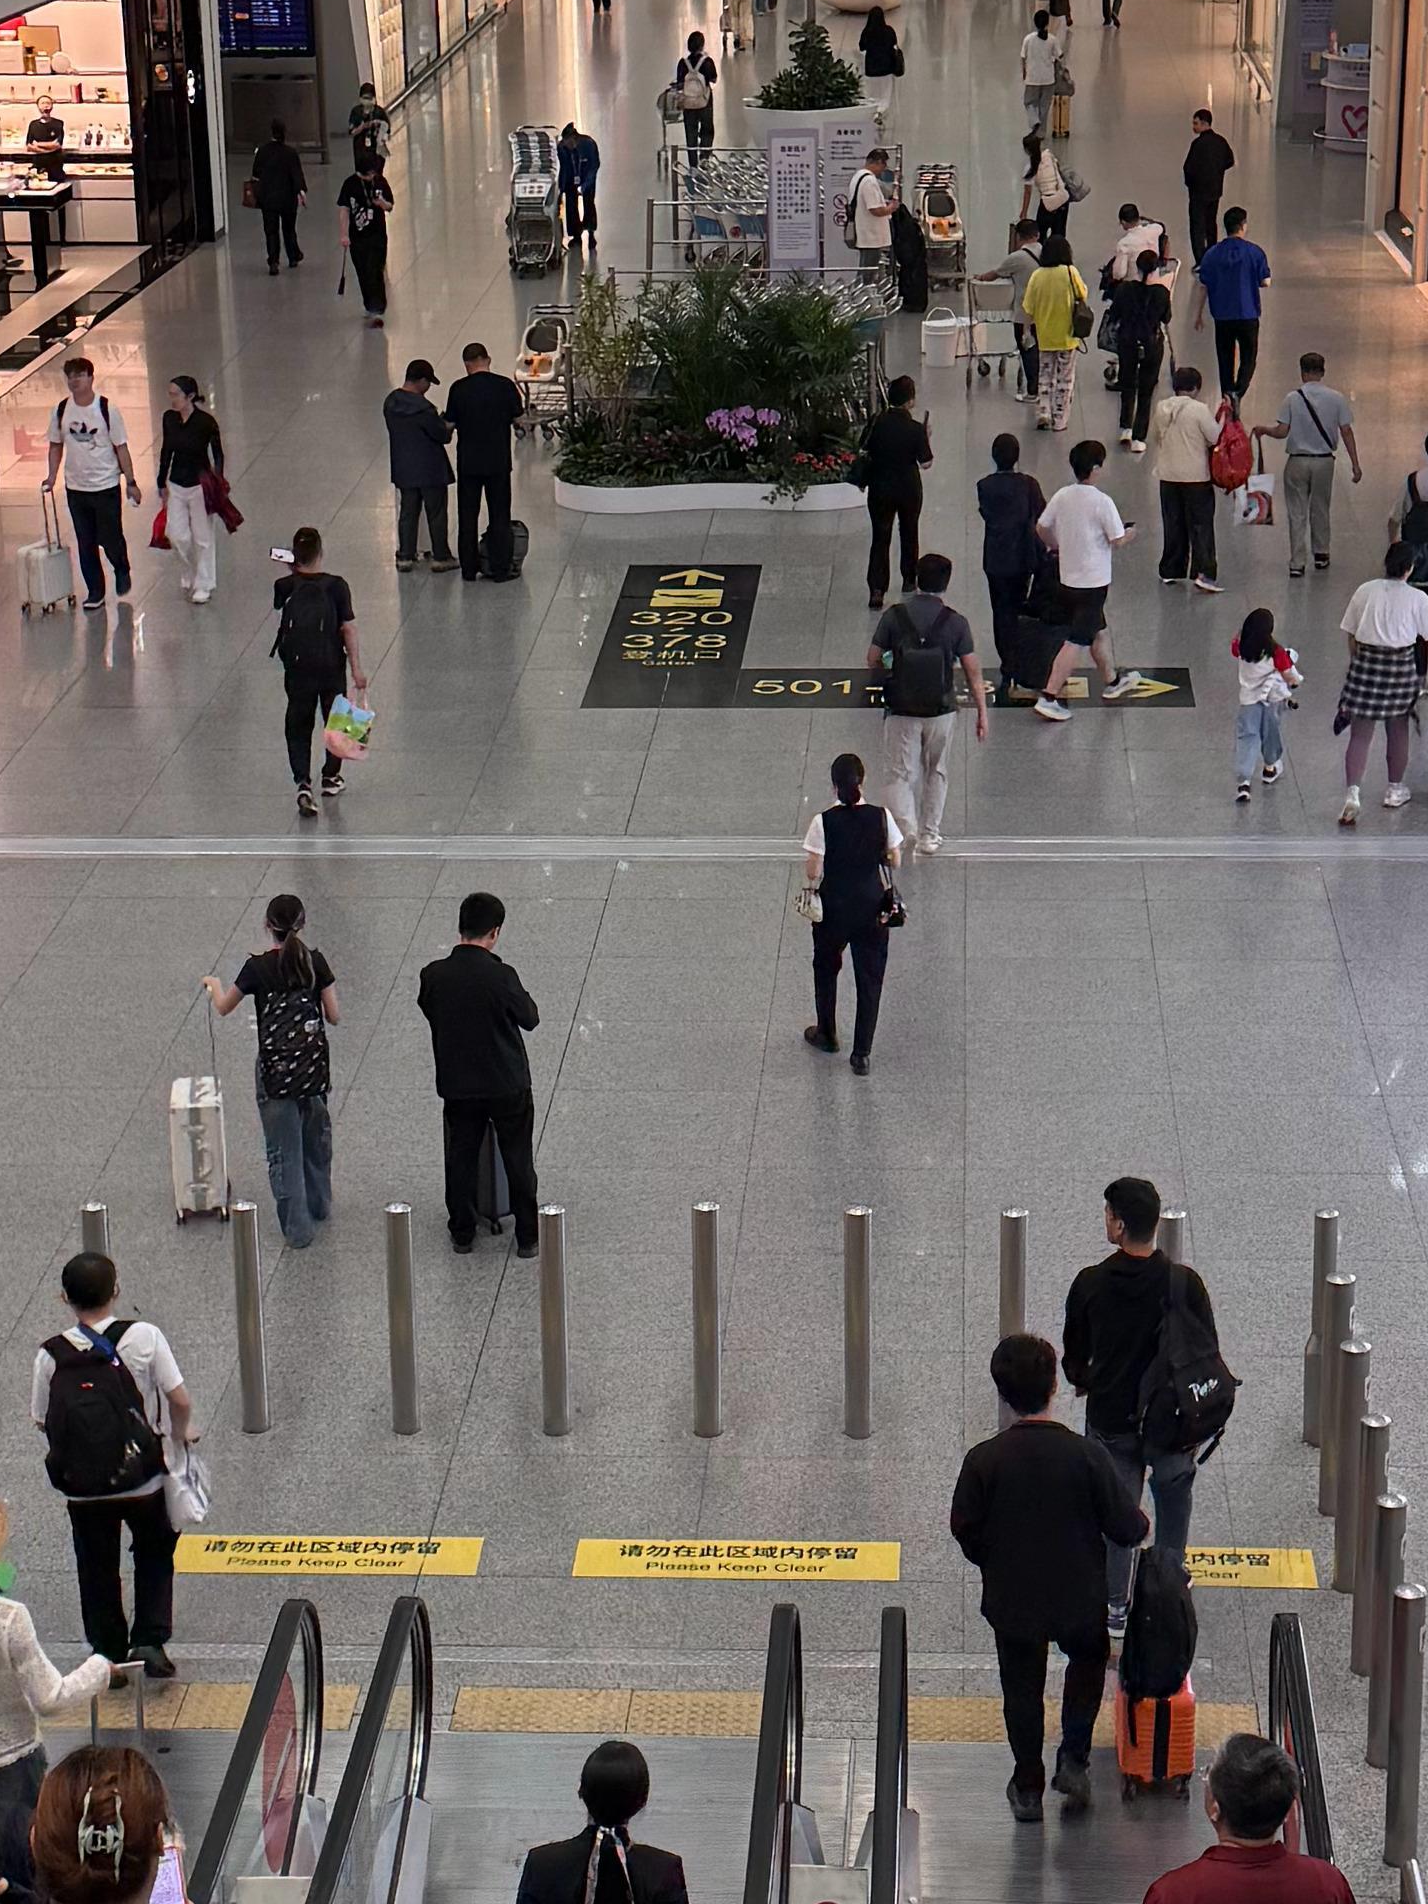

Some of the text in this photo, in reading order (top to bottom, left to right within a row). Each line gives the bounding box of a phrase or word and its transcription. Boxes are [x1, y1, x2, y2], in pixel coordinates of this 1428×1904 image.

[630, 611, 732, 625] 320
[622, 634, 727, 648] 378
[204, 1539, 442, 1555] 请勿在此区域内停留
[620, 1544, 859, 1560] 请勿在此区域内停留
[226, 1556, 406, 1568] Please Keep Clear
[1185, 1553, 1270, 1567] 内停留
[646, 1561, 828, 1574] Please Keep Clear
